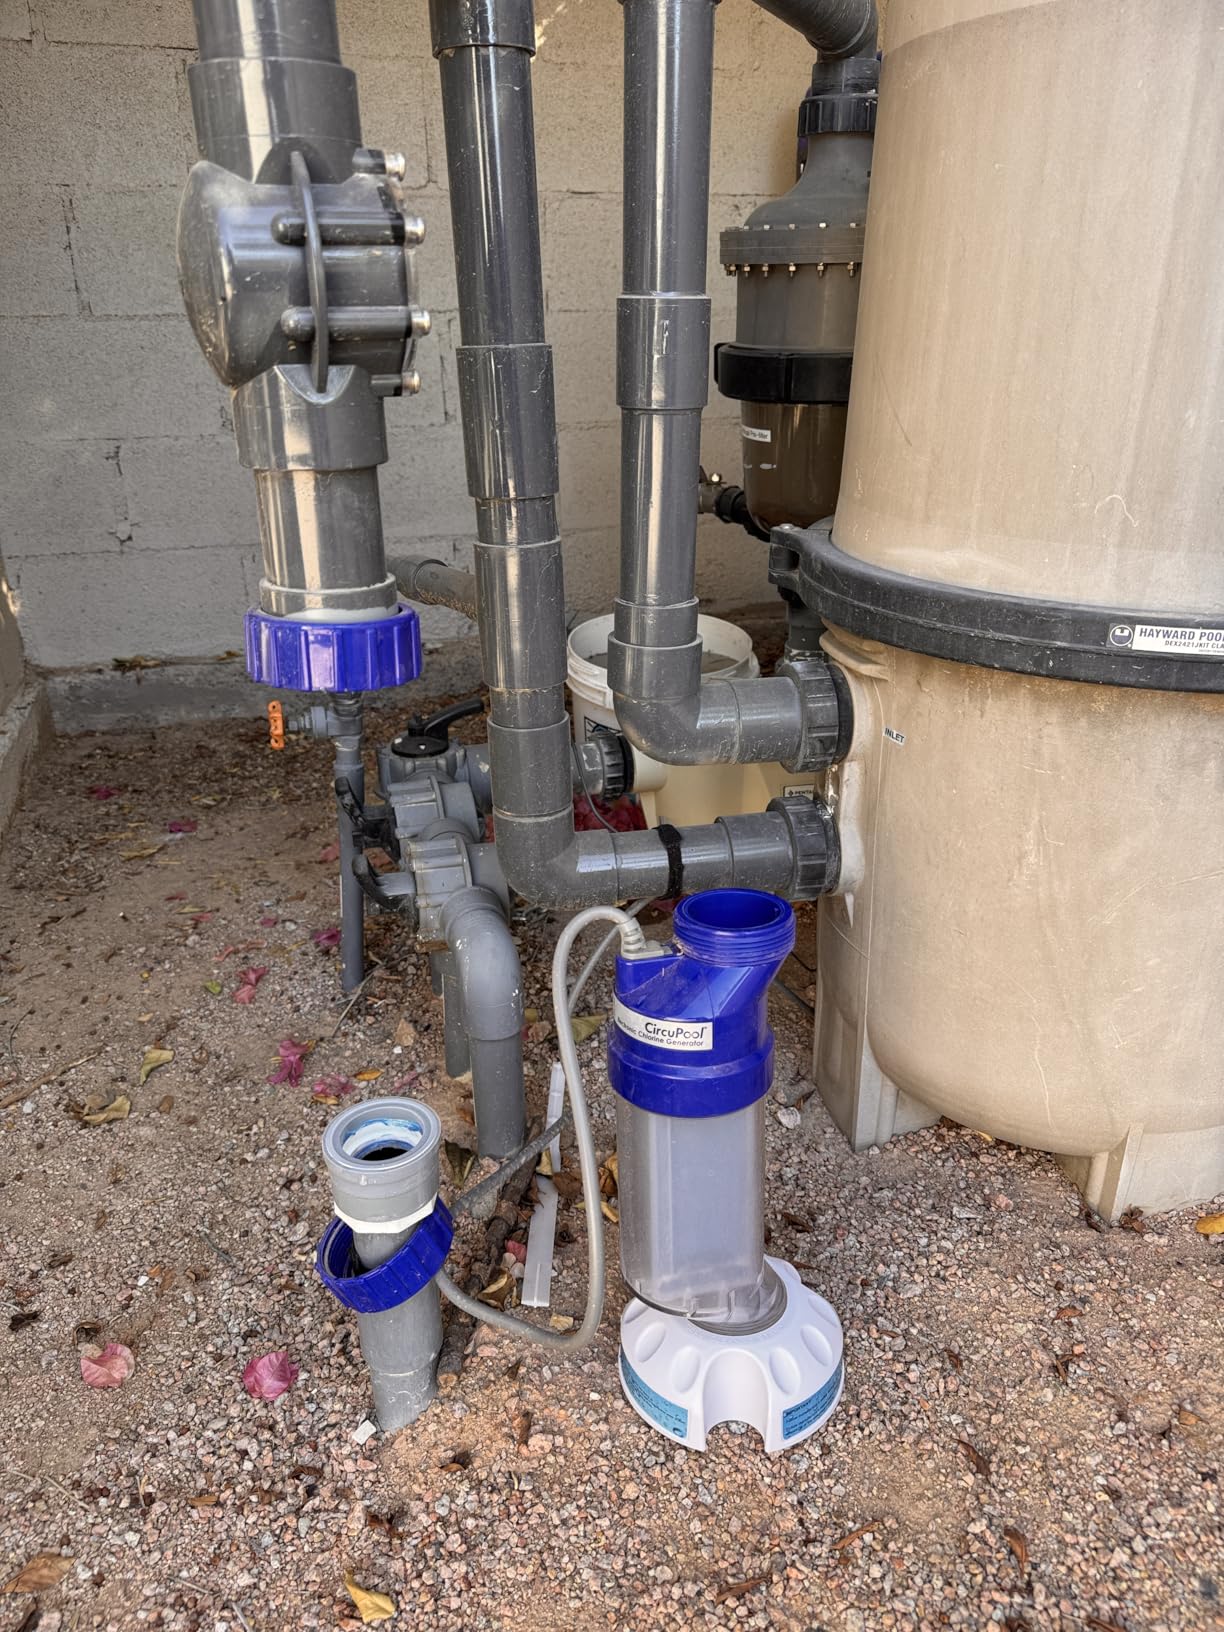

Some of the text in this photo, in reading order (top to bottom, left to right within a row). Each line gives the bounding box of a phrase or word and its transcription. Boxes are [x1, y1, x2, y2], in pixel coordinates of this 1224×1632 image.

[1139, 627, 1224, 642] HAYWARD POO
[885, 727, 904, 743] INLET
[638, 1029, 664, 1043] Chlorine
[666, 1038, 704, 1047] Generator
